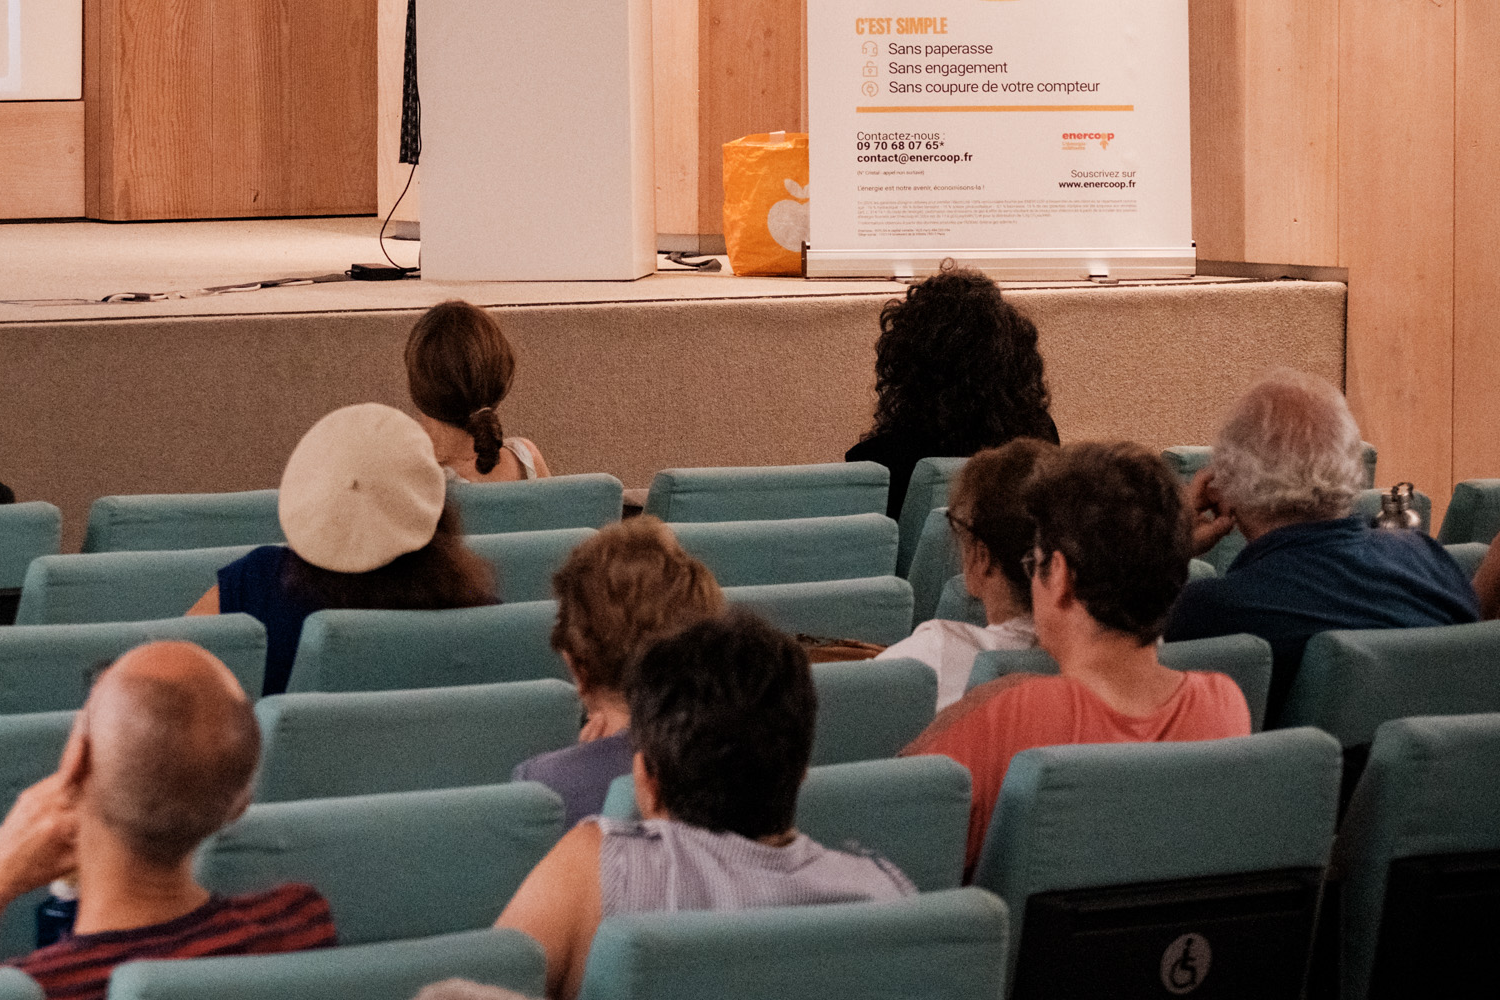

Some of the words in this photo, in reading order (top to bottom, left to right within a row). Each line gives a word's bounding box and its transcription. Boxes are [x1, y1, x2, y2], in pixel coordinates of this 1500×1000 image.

[856, 18, 892, 35] C'EST
[896, 17, 948, 34] SIMPLE
[888, 42, 922, 56] Sans
[925, 44, 993, 57] paperasse
[888, 62, 922, 74] Sans
[925, 62, 1008, 76] engagement
[889, 81, 922, 94] Sans
[926, 82, 978, 95] coupure
[982, 80, 998, 92] de
[1001, 82, 1034, 92] votre
[1036, 81, 1100, 94] compteur
[857, 132, 940, 141] Contactez-nous
[857, 142, 870, 150] 09
[874, 142, 888, 150] 70
[892, 141, 905, 150] 68
[908, 141, 922, 150] 07
[857, 152, 973, 164] contact@enercoop.fr
[1071, 170, 1119, 178] Souscrivez
[1059, 180, 1136, 189] www.enercoop.fr
